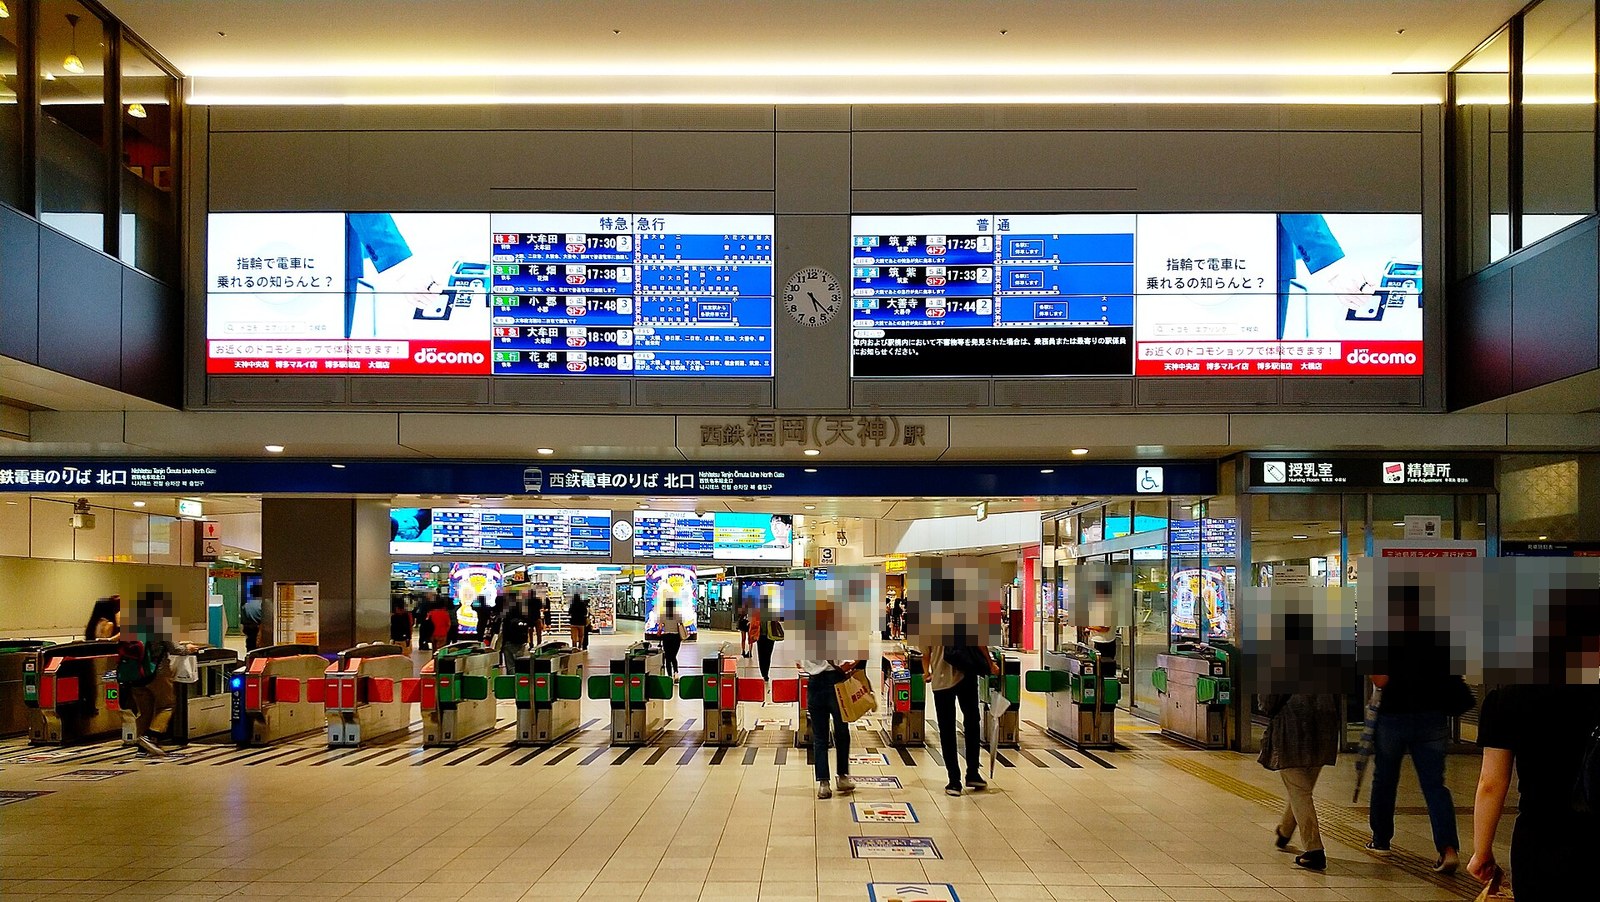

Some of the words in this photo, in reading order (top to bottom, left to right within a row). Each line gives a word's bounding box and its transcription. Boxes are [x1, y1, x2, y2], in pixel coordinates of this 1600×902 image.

[526, 234, 558, 244] 大牟田
[587, 238, 616, 248] 17:30
[621, 237, 628, 246] 3
[982, 238, 988, 246] 1
[947, 239, 976, 250] 17:25
[236, 257, 315, 270] 指輪で電車に
[1166, 258, 1247, 271] 指輪で電車に
[529, 265, 557, 275] 花畑
[587, 269, 616, 280] 17:38
[947, 270, 976, 280] 17:33
[982, 269, 988, 277] 2
[217, 276, 333, 288] 乗れるの知らんと？
[1146, 277, 1265, 290] 乗れるの知らんと？
[587, 300, 616, 311] 17:48
[887, 298, 918, 308] 大善寺
[946, 301, 976, 312] 17:44
[527, 328, 558, 338] 大牟田
[588, 332, 616, 342] 18:00
[622, 331, 628, 339] 3
[414, 348, 484, 364] docomo
[1145, 346, 1332, 356] お近くのドコモショップで体験できます！
[1346, 348, 1417, 364] docomo
[529, 352, 557, 362] 花畑
[588, 356, 616, 366] 18:08
[700, 416, 925, 447] 西鉄福岡(天神)駅
[1288, 463, 1332, 477] 授乳室
[1407, 463, 1451, 477] 精算所
[0, 469, 90, 484] 鉄電車のりば
[96, 470, 126, 484] 北口
[550, 472, 658, 488] 西鉄電車のりば
[664, 472, 694, 488] 北口
[823, 549, 832, 558] 3
[108, 690, 117, 699] IC
[898, 690, 908, 700] IC
